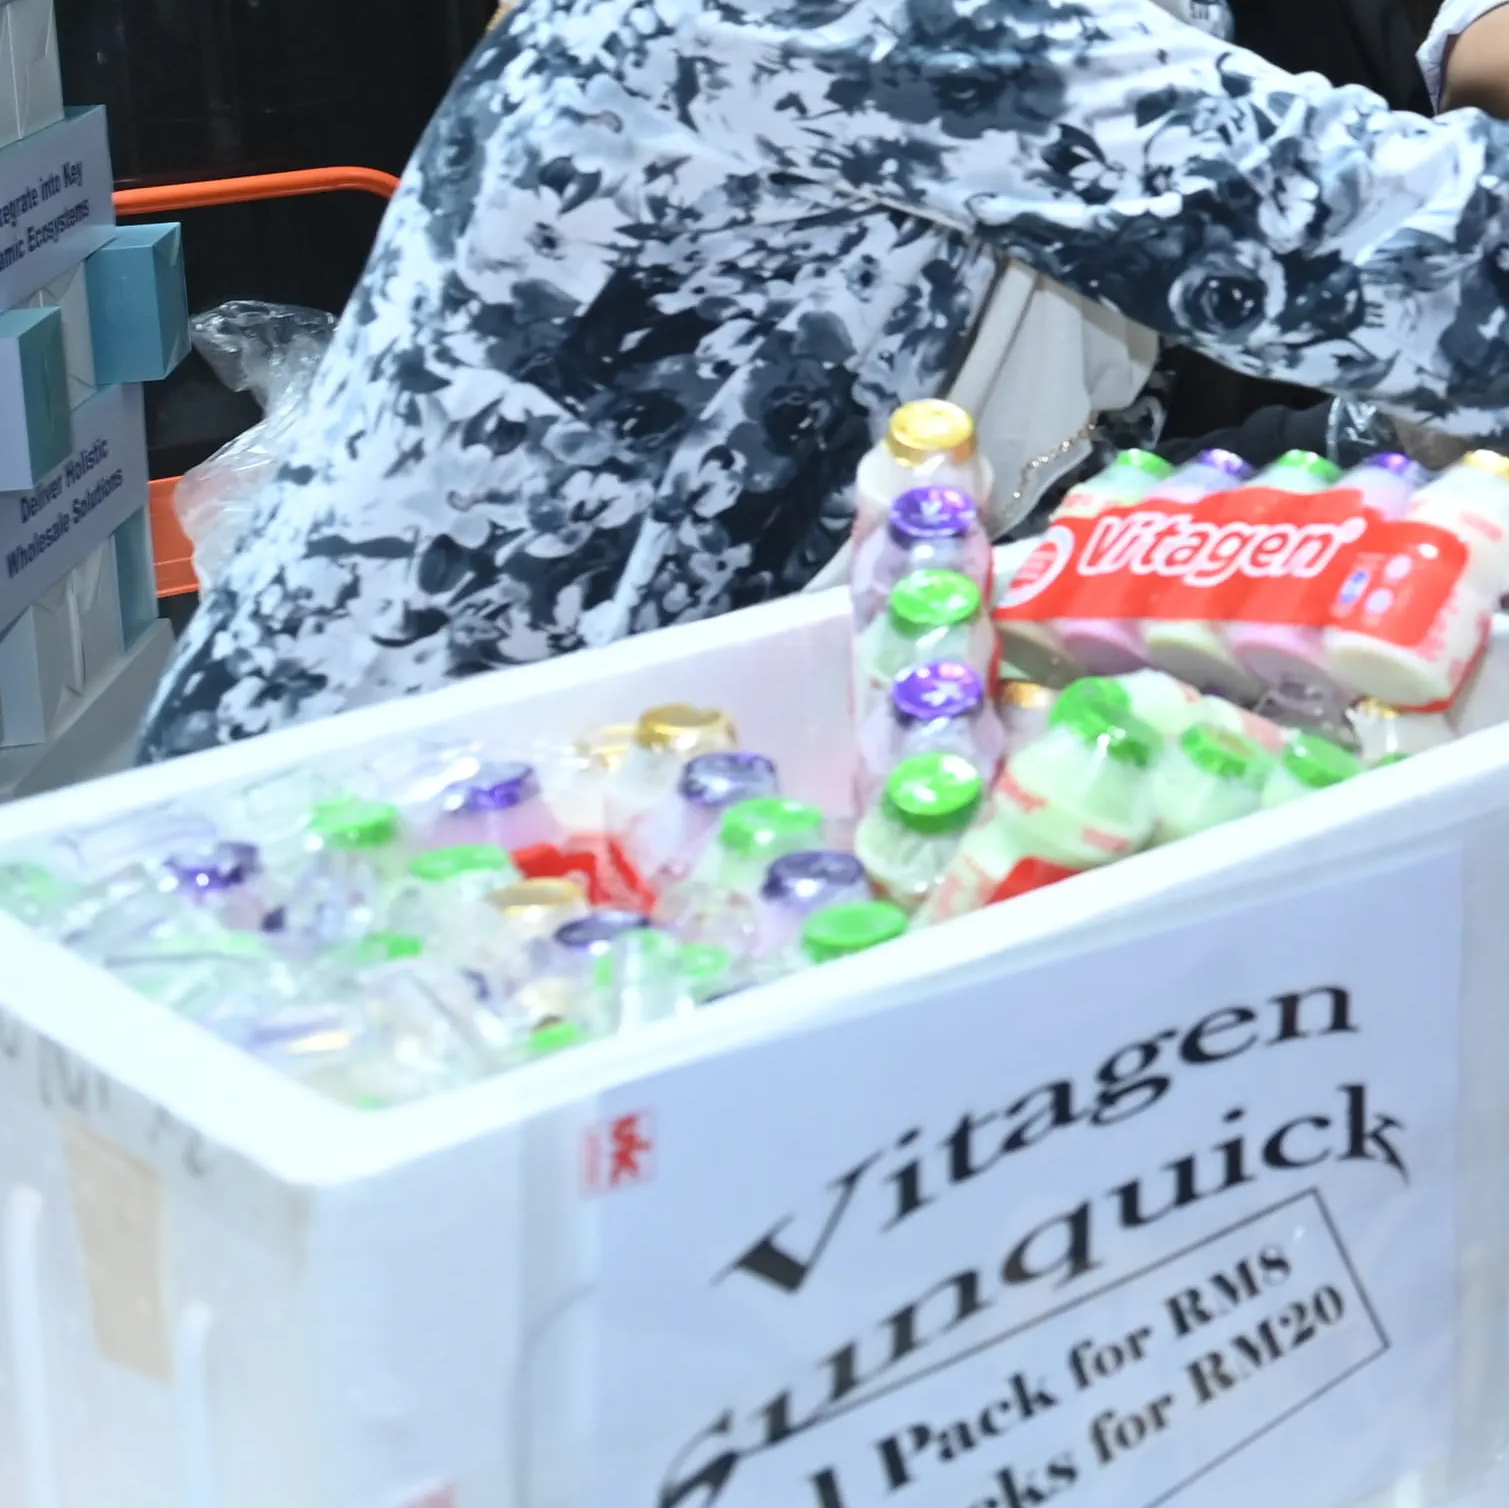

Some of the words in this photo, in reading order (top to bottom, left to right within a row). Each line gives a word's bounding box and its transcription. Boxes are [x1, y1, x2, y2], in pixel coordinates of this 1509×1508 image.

[27, 198, 91, 253] Ecosystems
[39, 172, 62, 201] into
[62, 160, 83, 188] Key
[65, 438, 109, 489] Holistic
[6, 511, 71, 579] Wholesale
[72, 467, 124, 525] Solutions
[1078, 511, 1342, 587] Vitagen
[711, 982, 1362, 1293] Vitagen
[874, 1371, 1061, 1492] Pack
[1067, 1325, 1154, 1392] for
[1164, 1243, 1292, 1339] RM8
[1089, 1392, 1175, 1465] for
[1186, 1283, 1346, 1406] RM20
